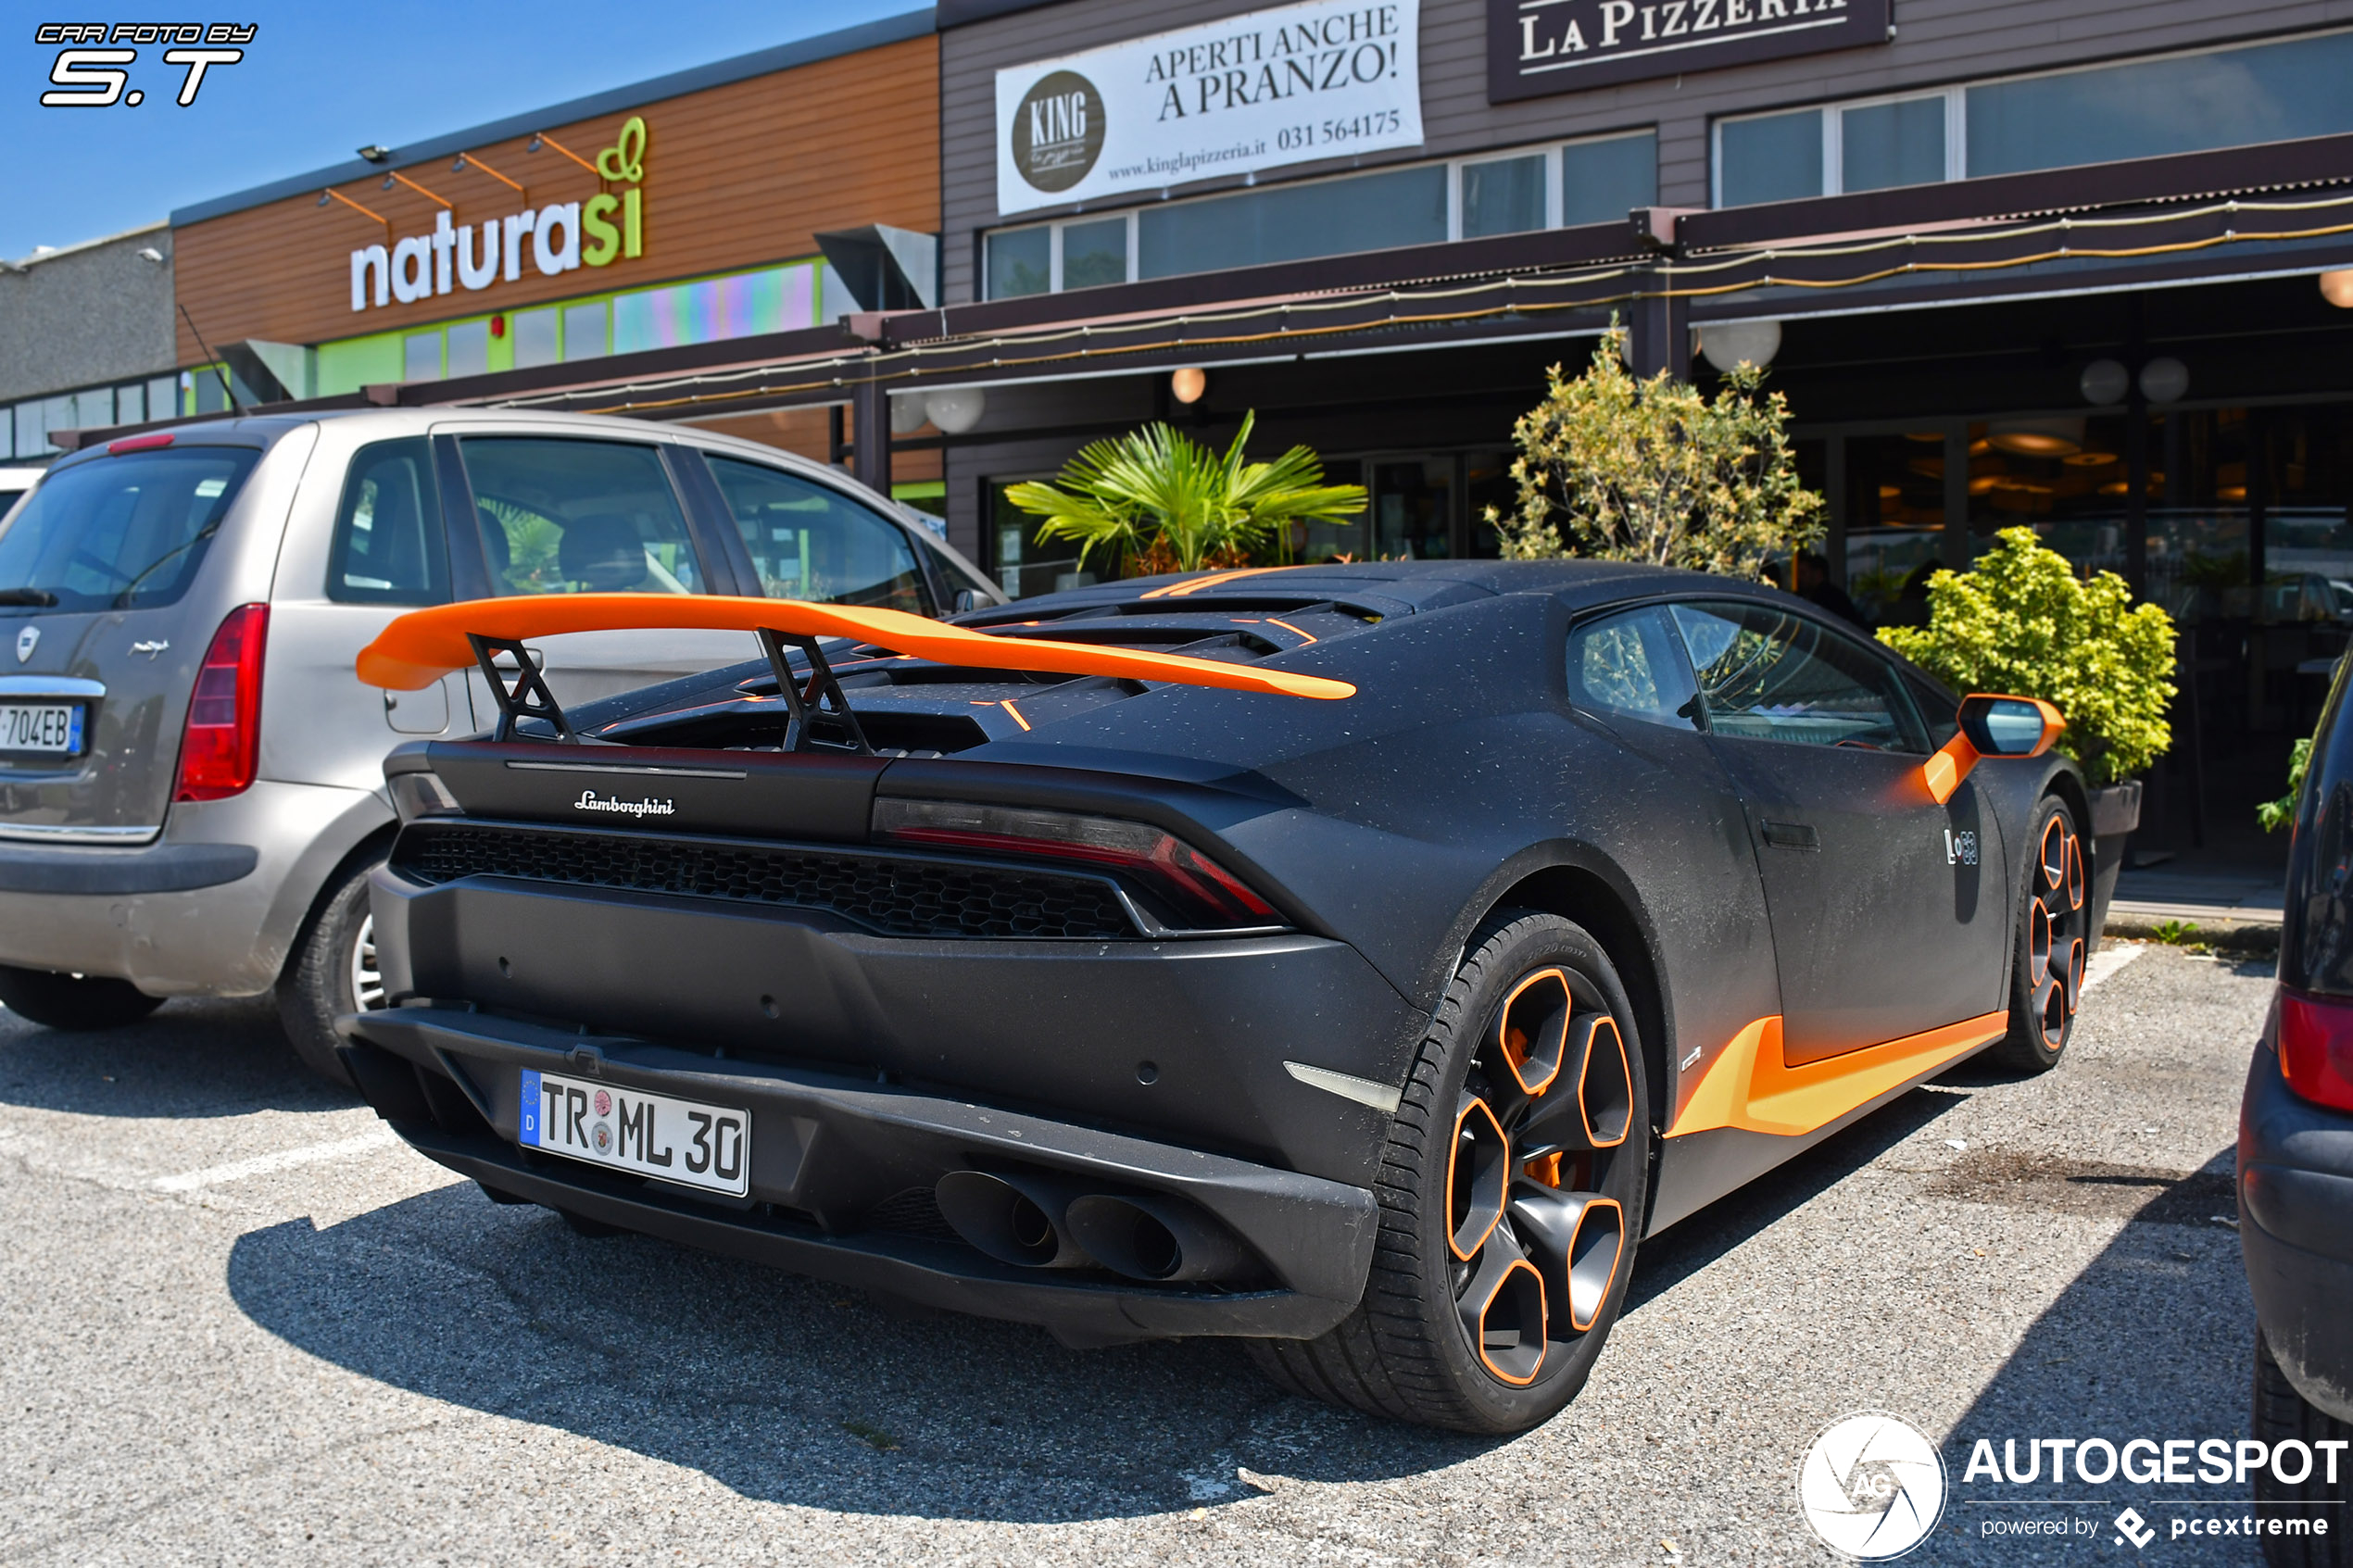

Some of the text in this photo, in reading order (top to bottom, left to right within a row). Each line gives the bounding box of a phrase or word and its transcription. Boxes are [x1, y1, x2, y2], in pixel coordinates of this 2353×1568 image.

[1145, 5, 1399, 83] APERTI ANCHE
[1518, 15, 1589, 61] LA
[1157, 41, 1398, 122] A PRANZO!
[1030, 91, 1087, 147] KING
[1277, 108, 1401, 151] 031 564175
[1108, 139, 1266, 181] www.kinglapizzeria.it
[350, 187, 643, 312] naturasi
[573, 790, 675, 819] Lamborghini
[523, 1113, 535, 1132] D
[618, 1098, 673, 1168] ML
[685, 1110, 743, 1181] 30
